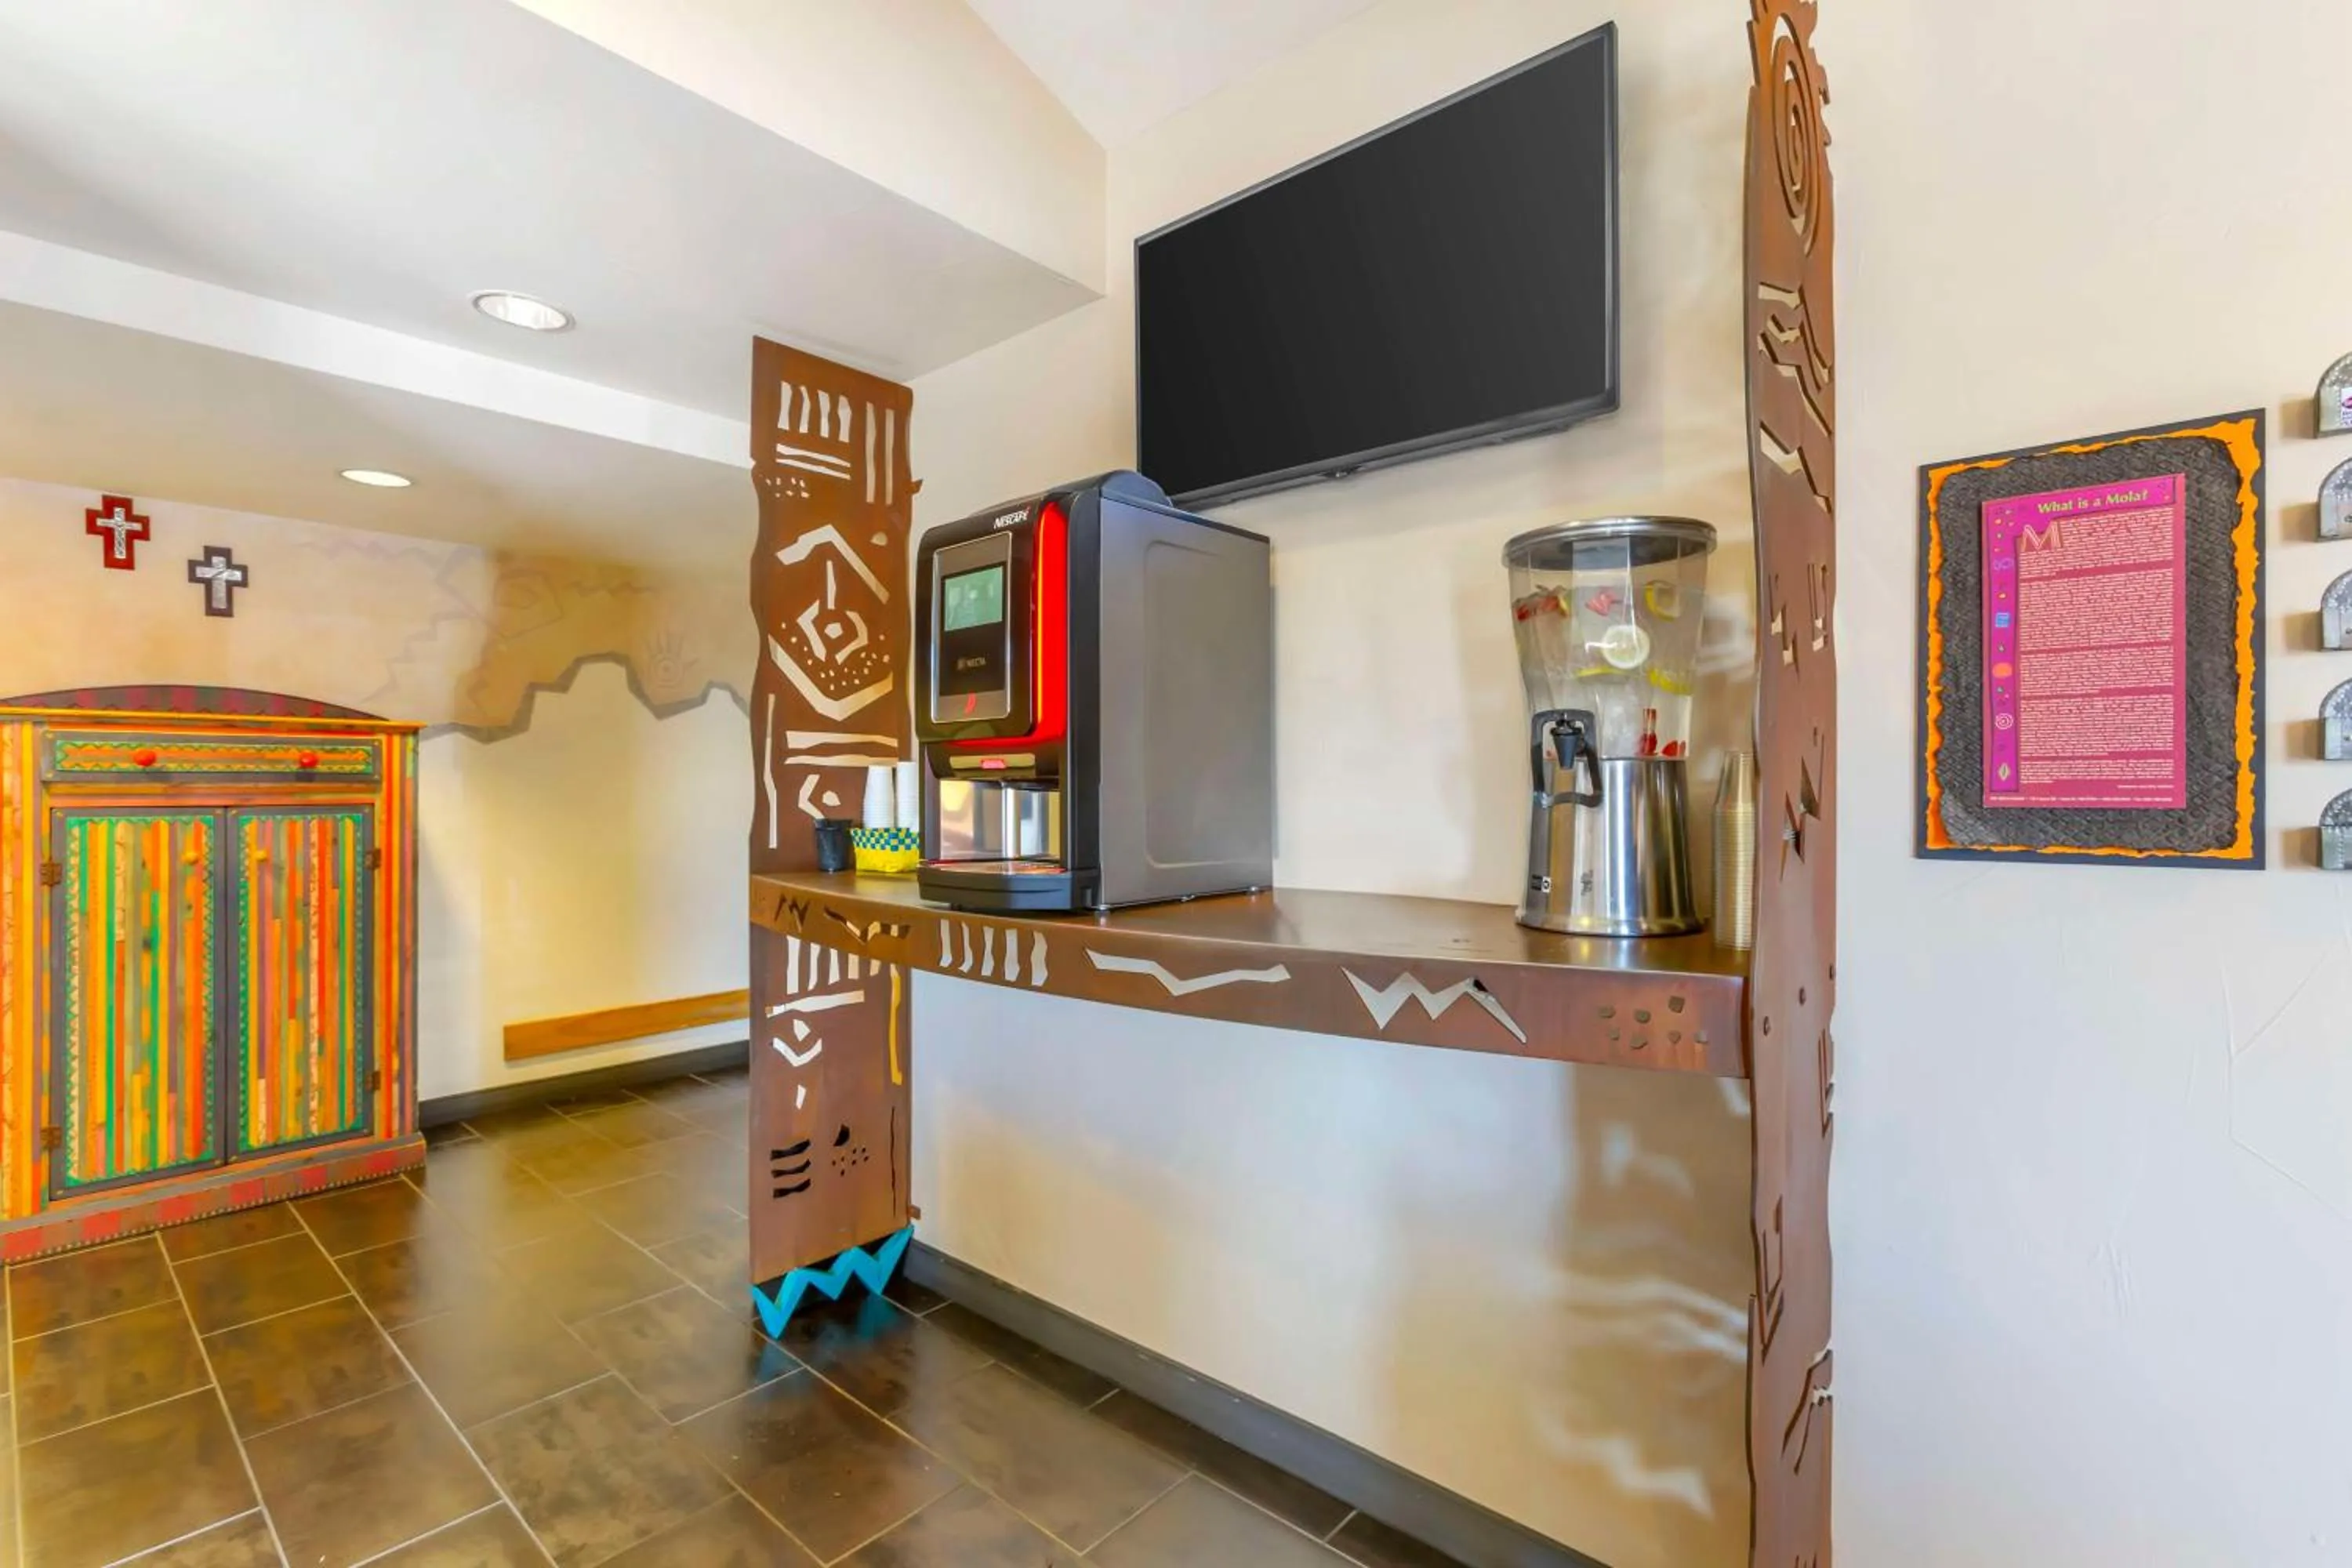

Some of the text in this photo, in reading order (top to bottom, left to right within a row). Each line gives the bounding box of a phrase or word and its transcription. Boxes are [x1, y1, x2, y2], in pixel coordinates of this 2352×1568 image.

[2038, 489, 2148, 514] What is a Mola?
